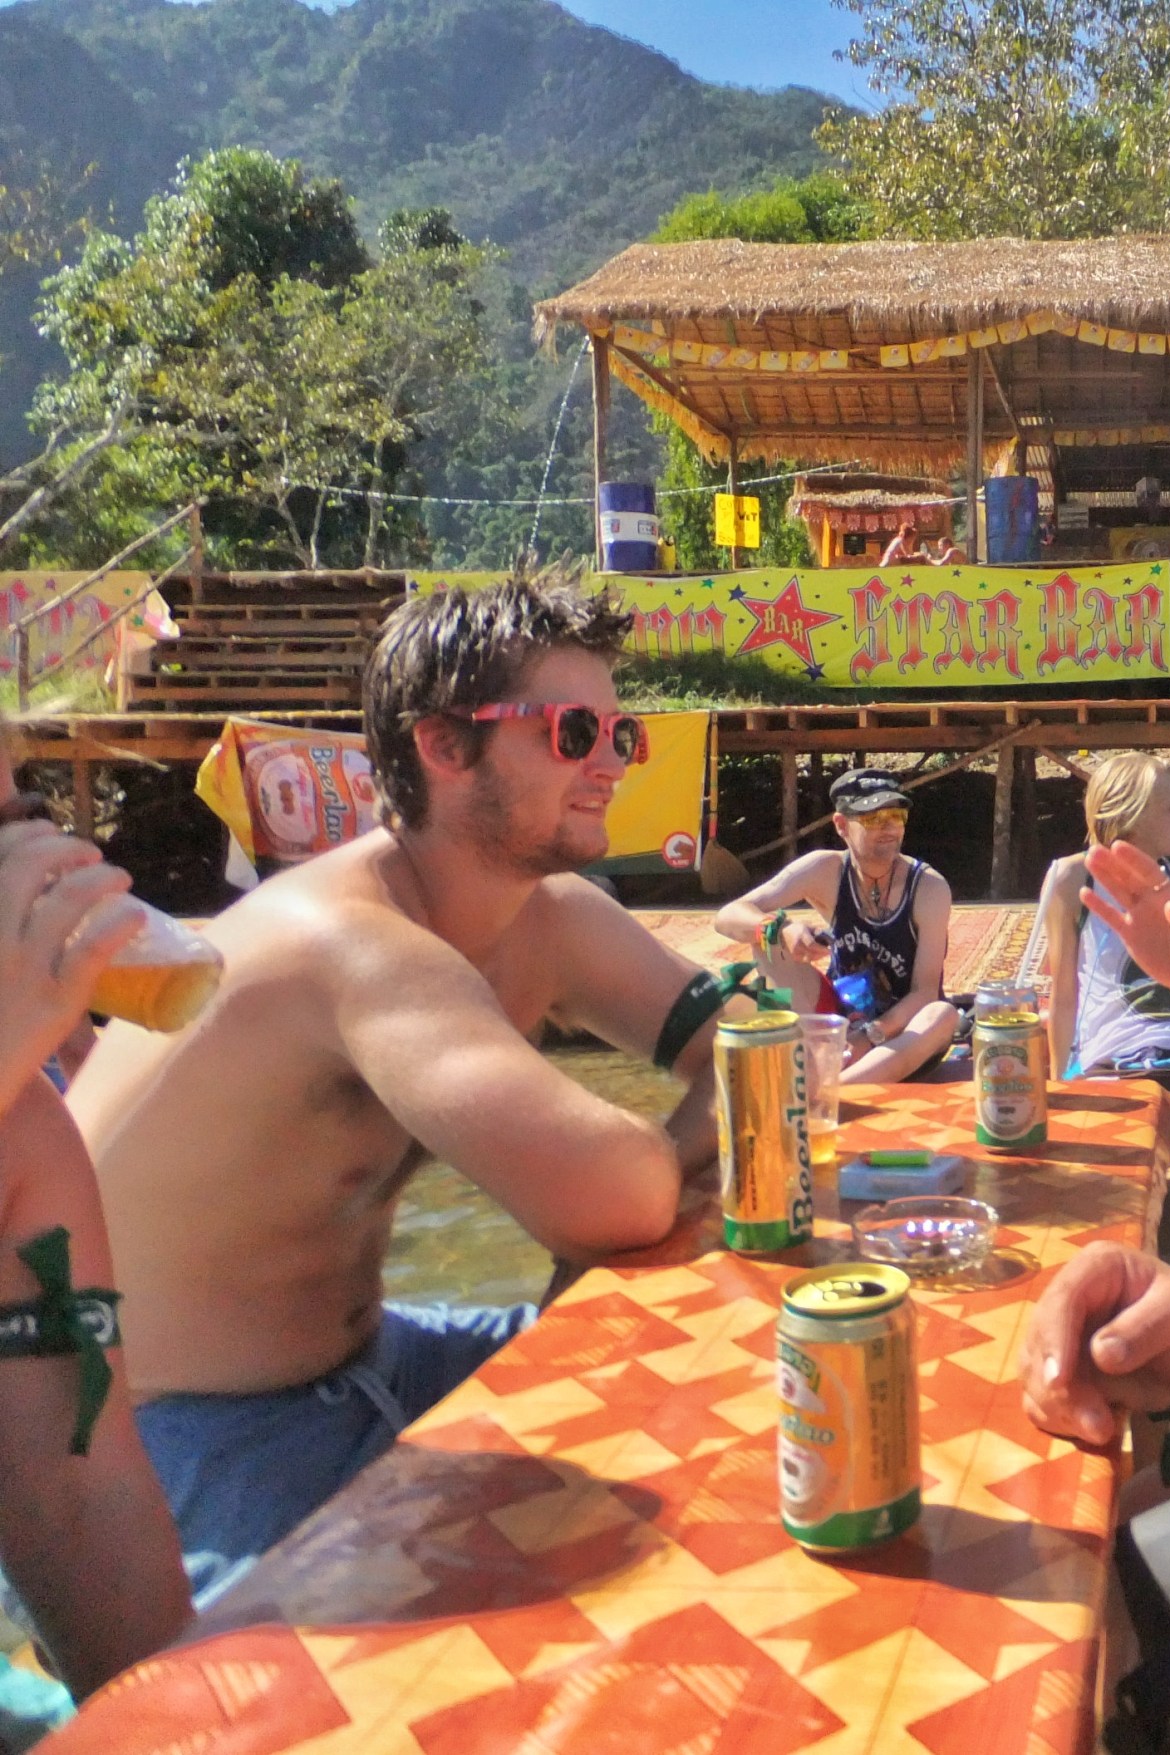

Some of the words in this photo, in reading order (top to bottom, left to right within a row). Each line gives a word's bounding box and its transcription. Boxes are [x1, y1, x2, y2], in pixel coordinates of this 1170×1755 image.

[763, 605, 804, 643] BAR
[848, 575, 1024, 684] STAR
[1036, 570, 1169, 678] BAR
[312, 747, 347, 842] Beerlao
[788, 1043, 814, 1229] Beerlao
